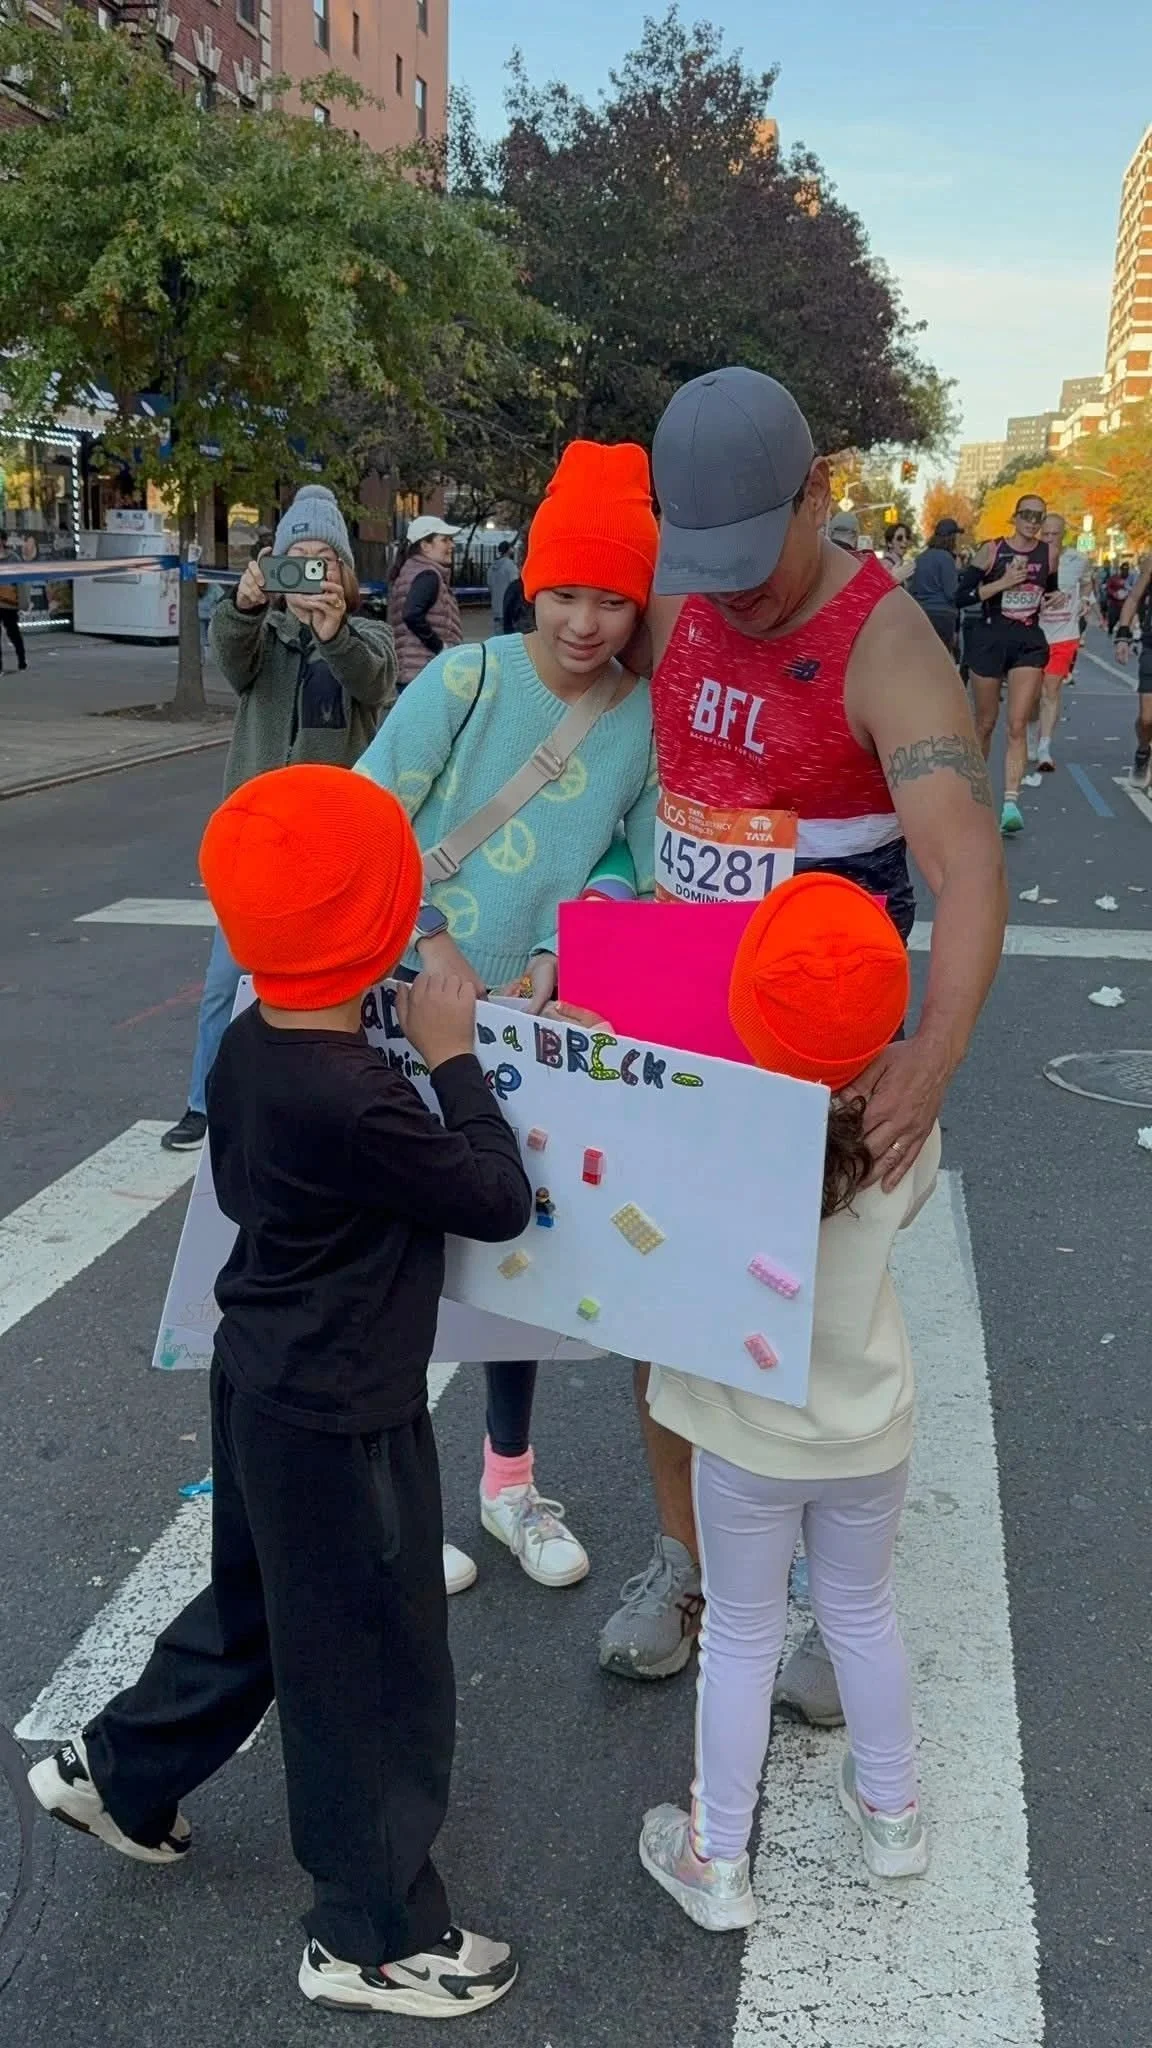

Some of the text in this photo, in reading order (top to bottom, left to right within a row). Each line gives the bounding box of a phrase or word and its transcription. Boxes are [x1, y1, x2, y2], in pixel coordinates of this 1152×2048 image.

[692, 677, 766, 754] BFL
[660, 831, 775, 897] 45281
[744, 831, 773, 842] TATA
